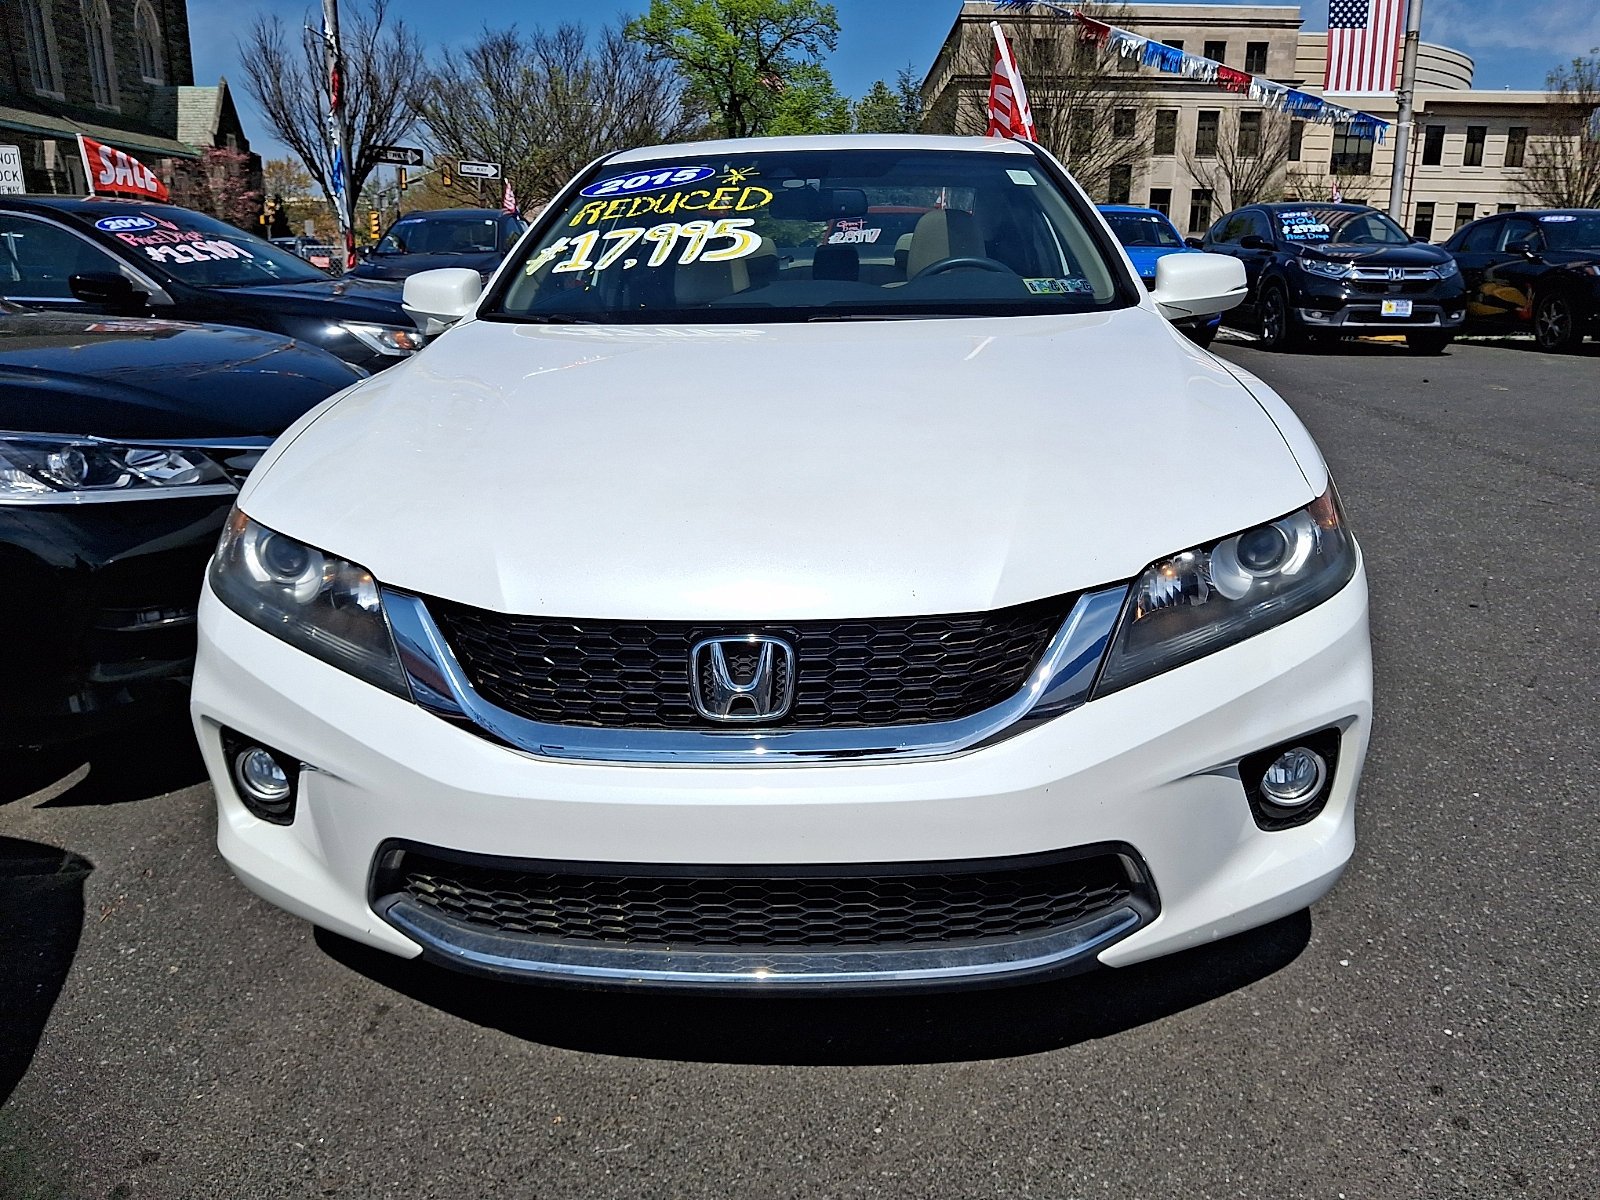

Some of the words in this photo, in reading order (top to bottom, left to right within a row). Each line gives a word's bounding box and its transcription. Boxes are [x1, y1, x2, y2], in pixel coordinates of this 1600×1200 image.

[98, 145, 158, 193] SALE
[599, 168, 702, 194] 2015
[569, 186, 774, 227] REDUCED
[104, 217, 151, 230] 2014
[1282, 217, 1316, 225] WOW
